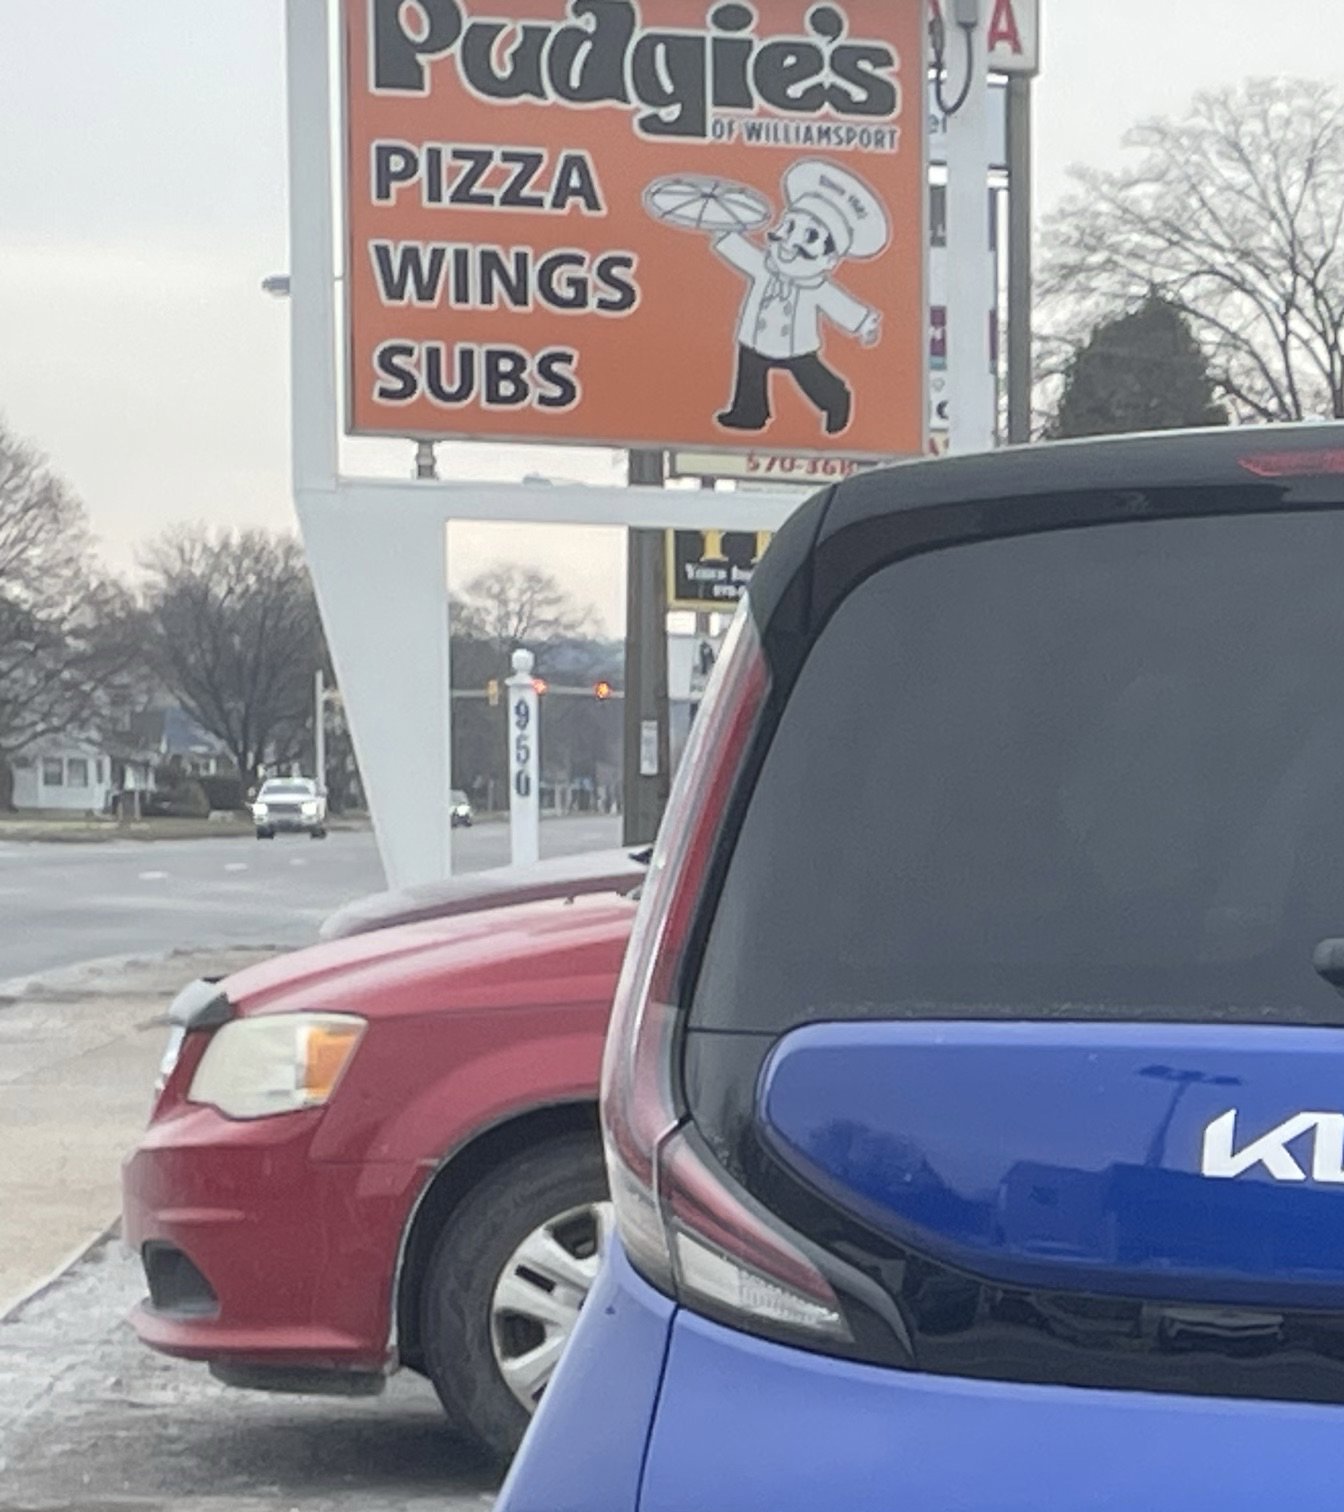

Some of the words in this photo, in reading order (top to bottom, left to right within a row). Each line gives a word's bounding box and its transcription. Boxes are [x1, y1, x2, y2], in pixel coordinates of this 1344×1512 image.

[371, 0, 899, 140] Pudgie's
[711, 119, 737, 142] OF
[744, 120, 898, 150] WILLIAMSPORT
[373, 144, 604, 212] PIZZA
[371, 243, 638, 313] WINGS
[376, 342, 579, 408] SUBS
[514, 697, 531, 798] 950
